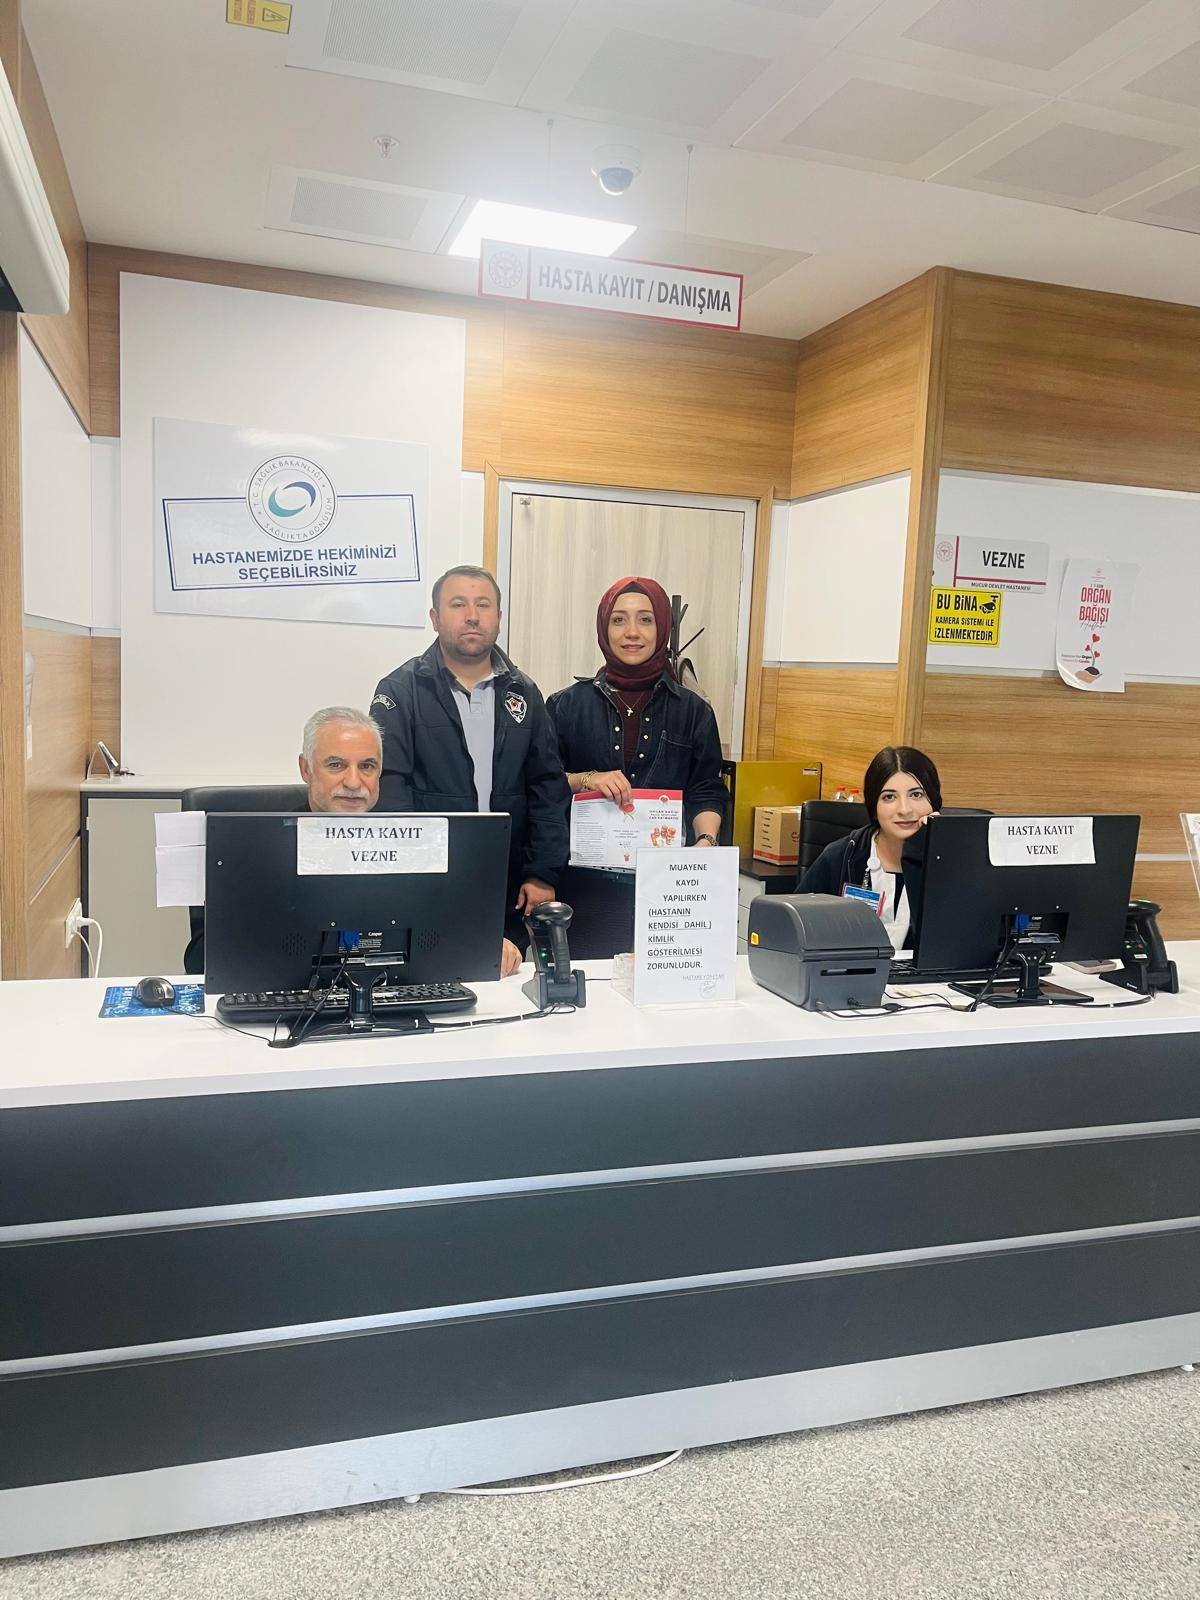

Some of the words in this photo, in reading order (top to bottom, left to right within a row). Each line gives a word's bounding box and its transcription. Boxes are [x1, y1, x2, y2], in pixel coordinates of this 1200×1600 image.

[539, 264, 593, 294] HASTA
[598, 271, 645, 300] KAYIT
[648, 279, 655, 303] /
[657, 281, 732, 315] DANIŞMA
[192, 547, 314, 565] HASTANEMİZDE
[318, 544, 397, 561] HEKİMİNİZİ
[982, 550, 1026, 569] VEZNE
[238, 562, 358, 582] SEÇEBİLİRSİNİZ
[1081, 586, 1112, 604] ORGAN
[936, 593, 951, 610] BU
[1079, 603, 1110, 625] BAĞIŞI
[935, 616, 960, 625] KAMERA
[934, 627, 993, 642] İZLENMEKTEDİR
[325, 827, 375, 839] HASTA
[379, 827, 423, 839] KAYIT
[1007, 825, 1041, 836] HASTA
[1044, 825, 1075, 835] KAYIT
[1027, 845, 1059, 855] VEZNE
[351, 850, 398, 862] VEZNE
[669, 863, 708, 872] MUAYENE
[675, 879, 699, 887] KAYDI
[663, 894, 707, 902] YAPILIRKEN
[648, 907, 691, 917] (HASTANIN
[648, 921, 679, 930] KENDİSİ
[647, 933, 675, 943] KİMLİK
[647, 946, 703, 957] GÖSTERİLMESİ
[647, 961, 703, 970] ZORUNLUDUR.
